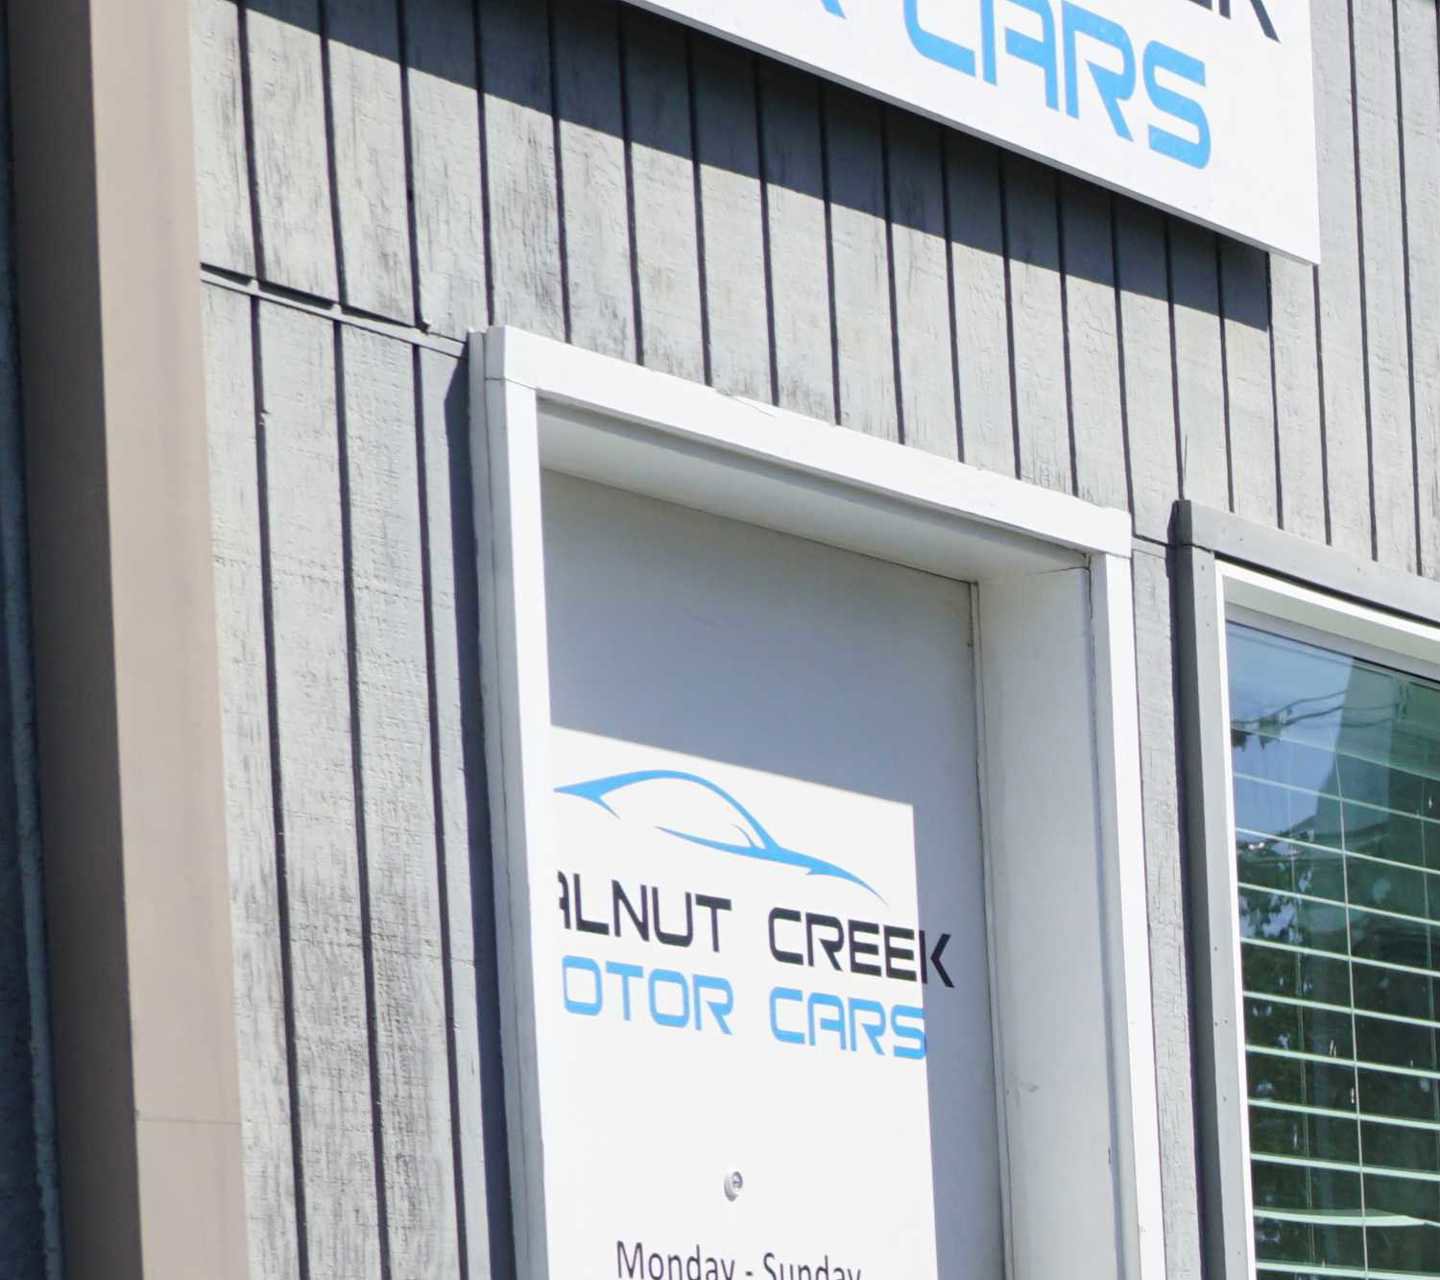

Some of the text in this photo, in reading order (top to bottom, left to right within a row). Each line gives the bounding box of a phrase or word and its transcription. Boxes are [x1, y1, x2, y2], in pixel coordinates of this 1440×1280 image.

[904, 0, 1211, 170] CARS
[768, 907, 955, 988] CREEK
[769, 986, 928, 1061] CARS
